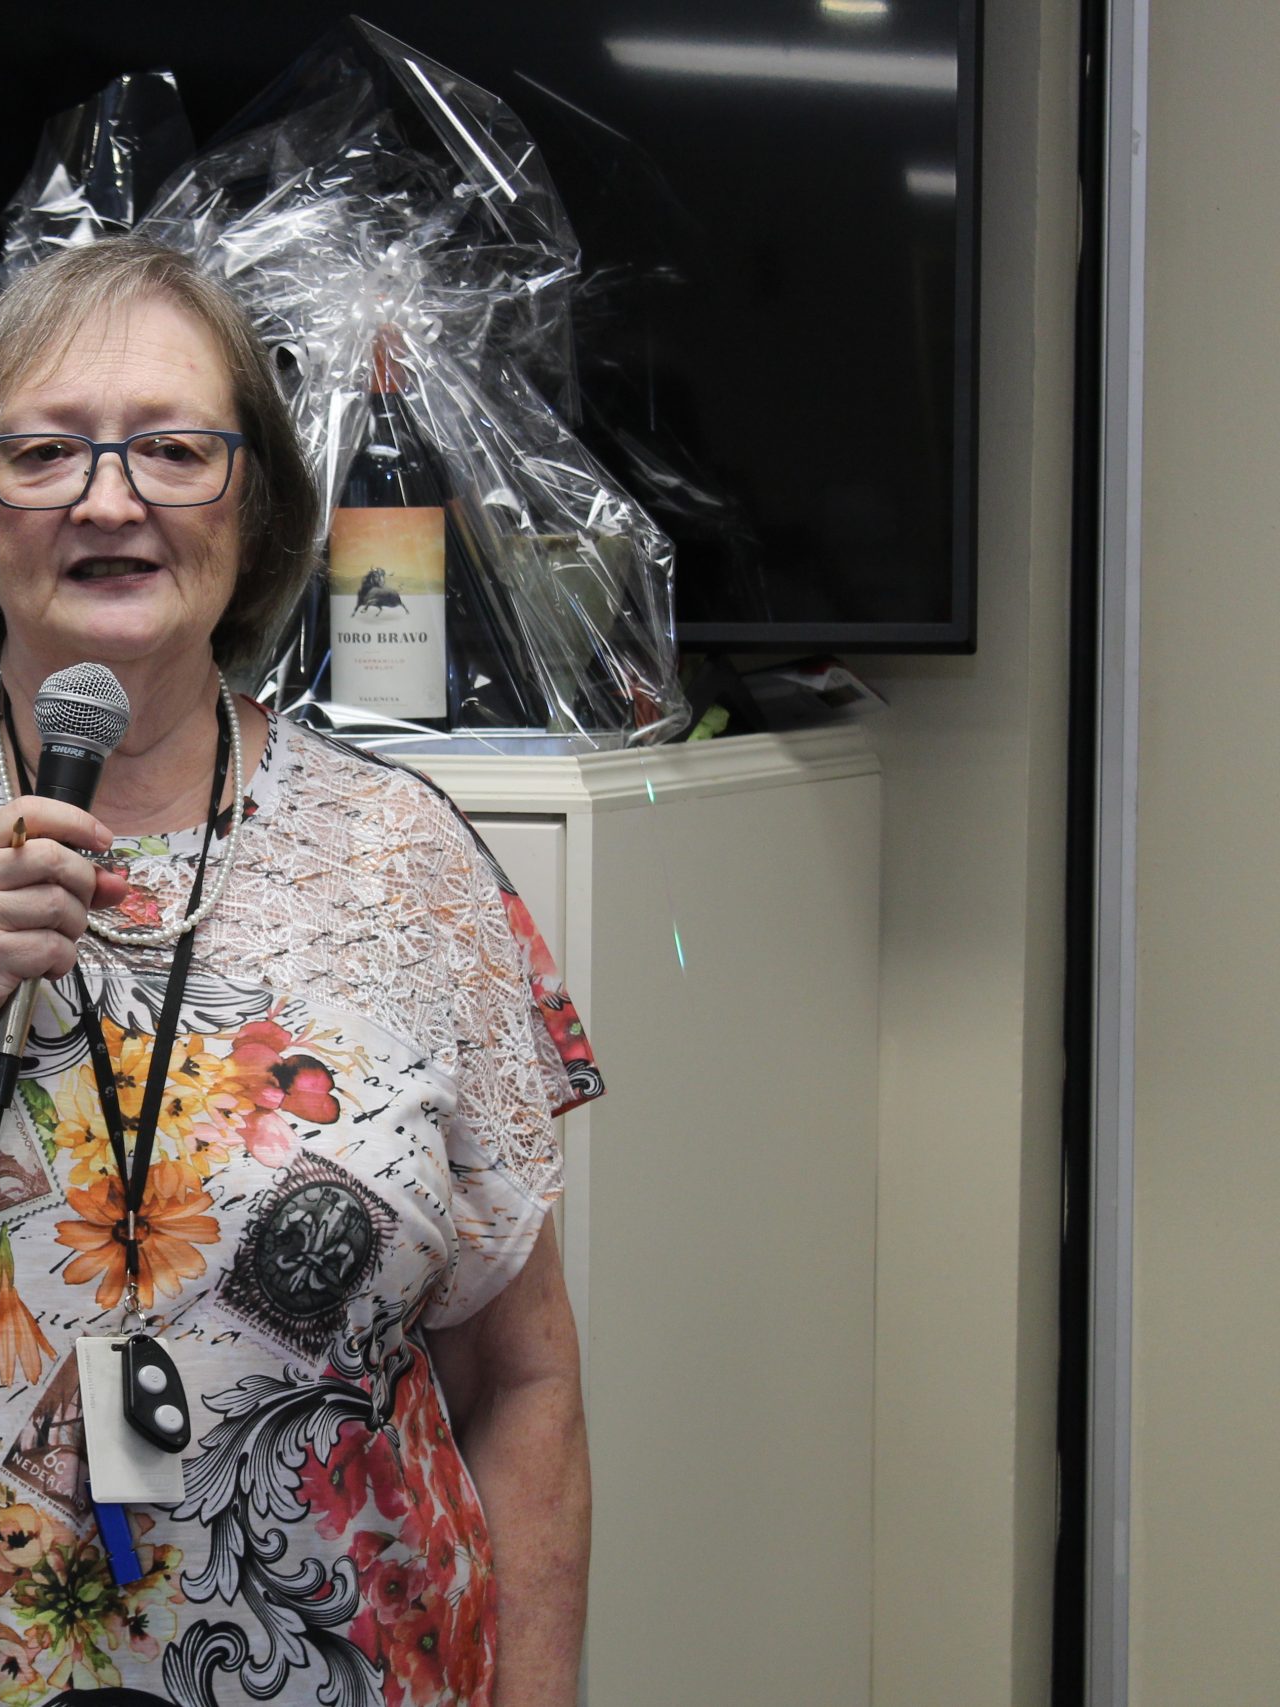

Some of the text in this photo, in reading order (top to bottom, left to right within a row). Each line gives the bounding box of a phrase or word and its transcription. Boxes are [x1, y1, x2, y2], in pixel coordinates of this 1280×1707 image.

[337, 631, 428, 644] TORO BRAVO
[50, 744, 87, 758] SHURE
[301, 1146, 348, 1179] WERELD
[350, 1178, 399, 1223] JAMBOREE
[11, 1451, 87, 1512] NEDERLAND
